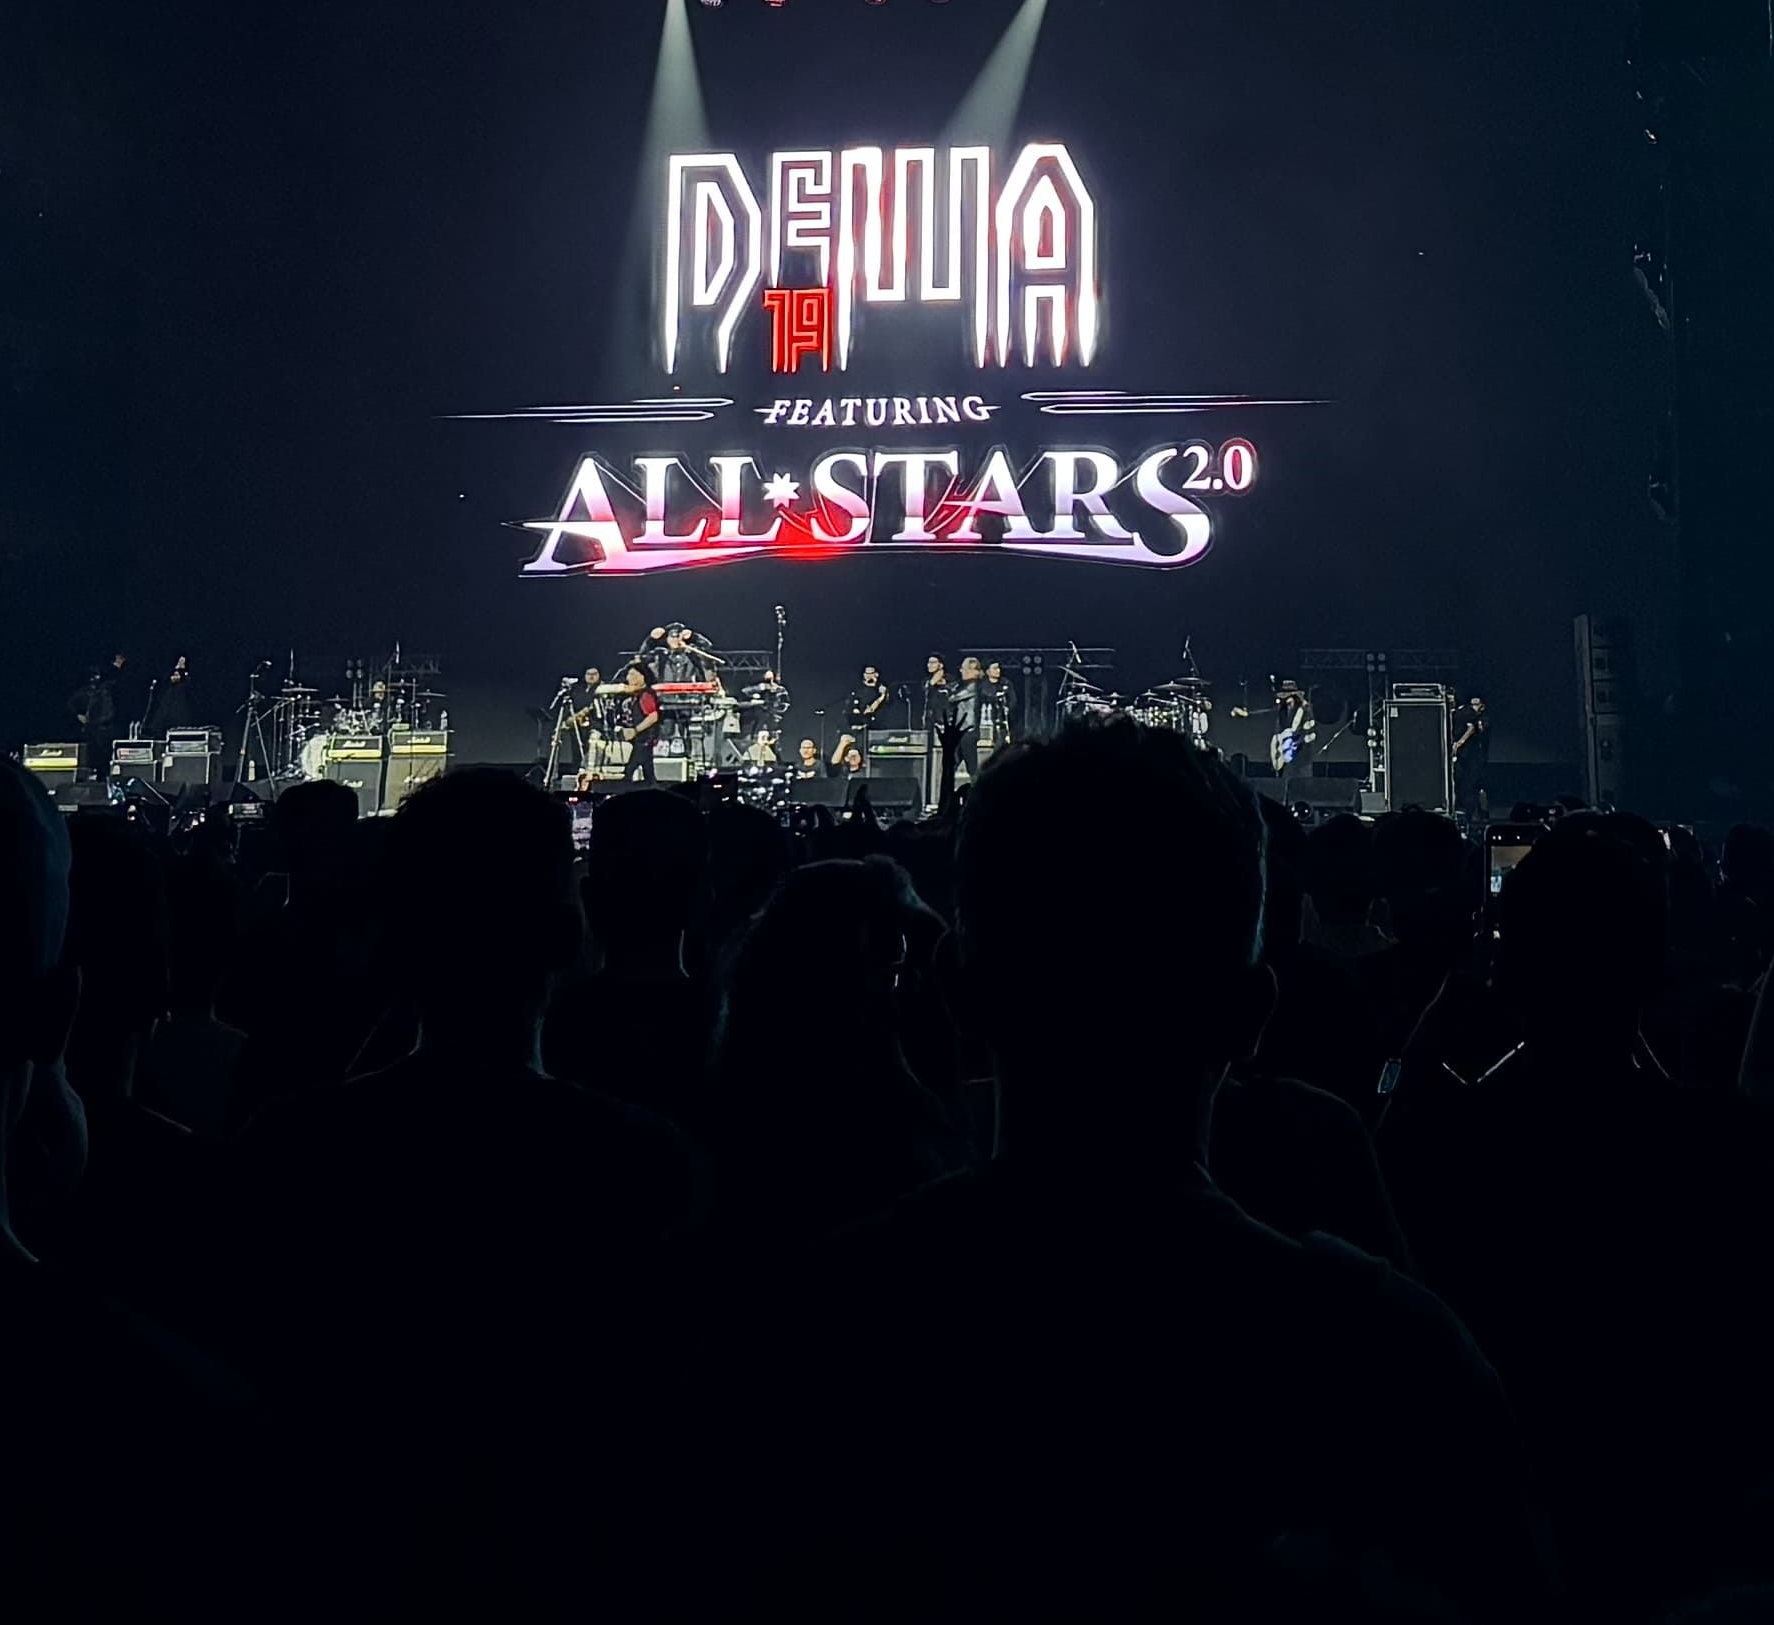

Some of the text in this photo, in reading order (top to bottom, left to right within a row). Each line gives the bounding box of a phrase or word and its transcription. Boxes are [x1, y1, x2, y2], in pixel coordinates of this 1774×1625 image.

[661, 142, 1097, 375] DEWA
[763, 287, 833, 374] 19
[761, 394, 993, 428] FEATURING
[515, 444, 1255, 576] ALL STARS 2.0
